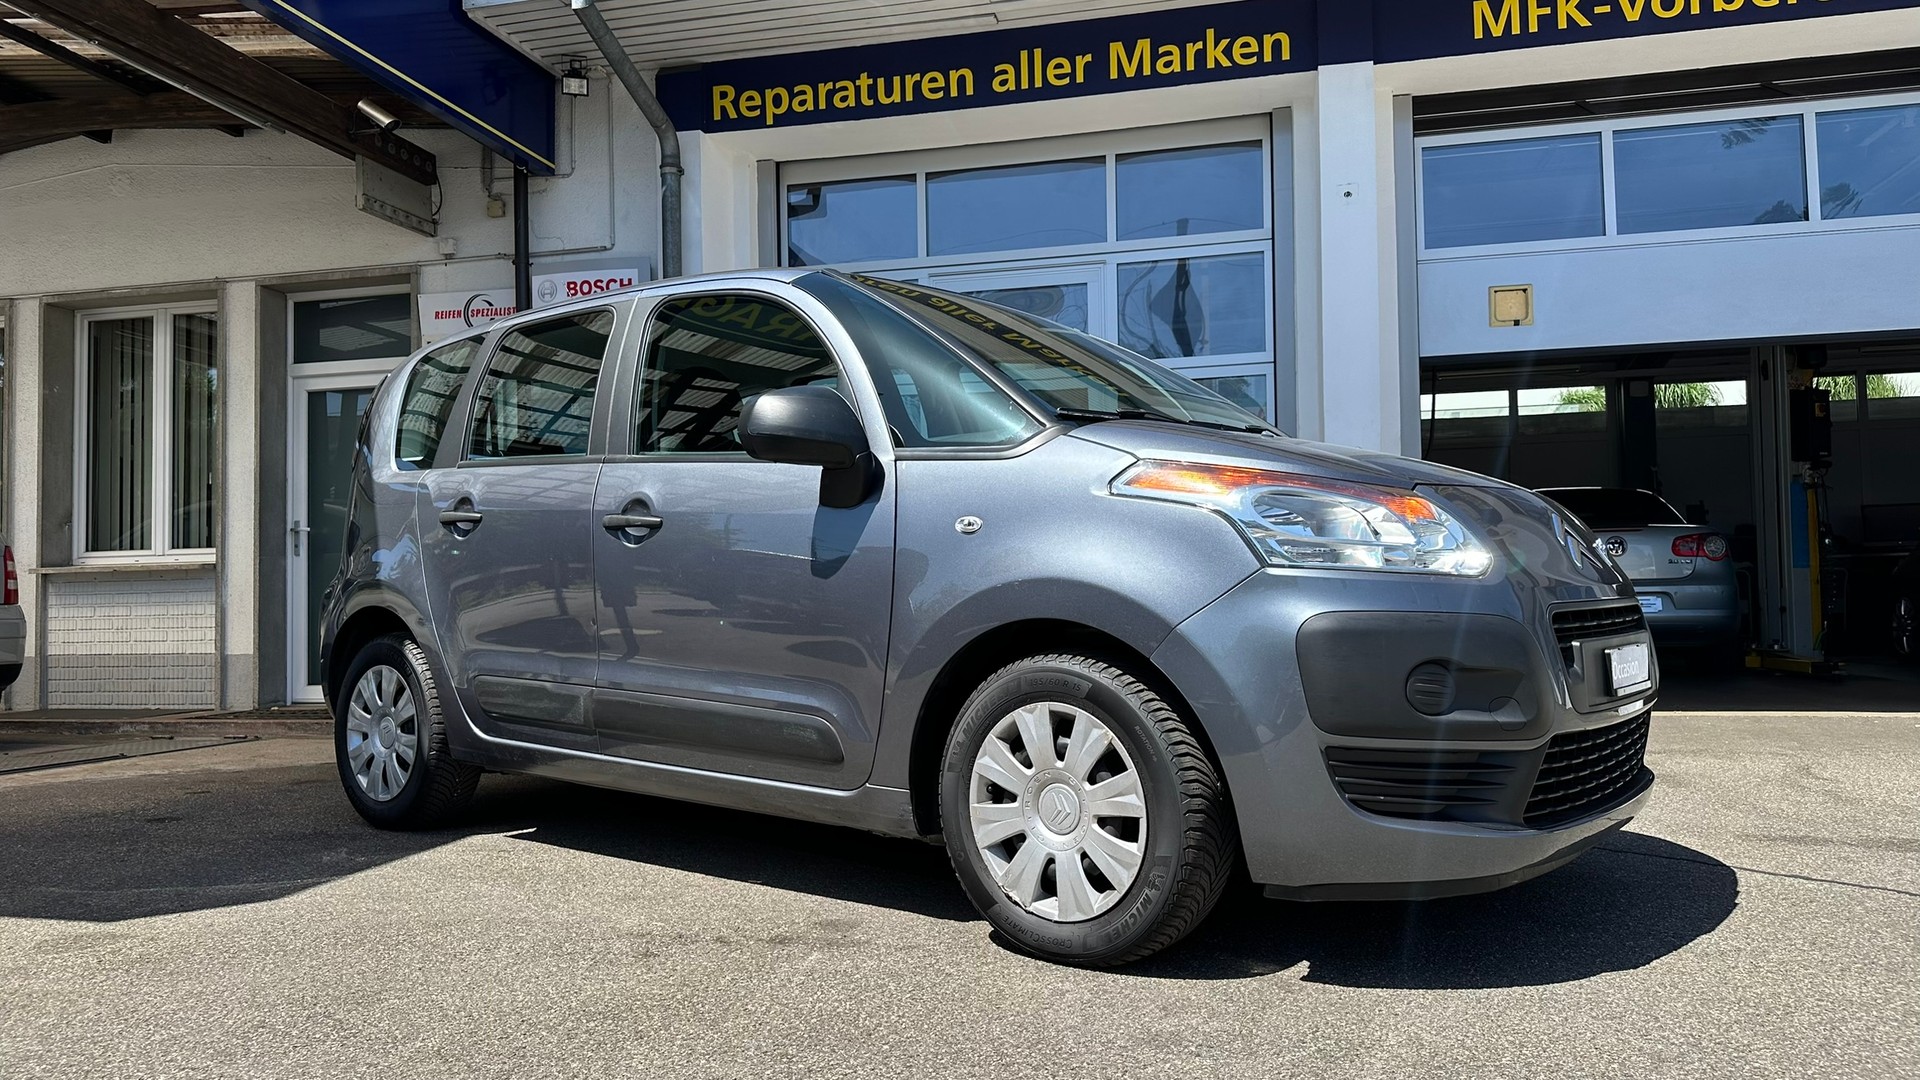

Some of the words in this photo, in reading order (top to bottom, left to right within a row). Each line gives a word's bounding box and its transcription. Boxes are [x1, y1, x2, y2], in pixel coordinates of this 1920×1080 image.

[1473, 0, 1831, 39] MFK-Vor
[712, 67, 975, 125] Reparaturen
[991, 48, 1092, 93] aller
[1109, 29, 1292, 80] Marken
[567, 278, 633, 297] BOSCH
[434, 309, 462, 320] REIFEN
[470, 306, 518, 318] SPEZIALIST
[1612, 658, 1640, 680] Occasion
[1030, 677, 1060, 688] 195/60
[1062, 680, 1070, 688] R
[1072, 682, 1083, 692] 15
[1134, 725, 1155, 755] ROTATION
